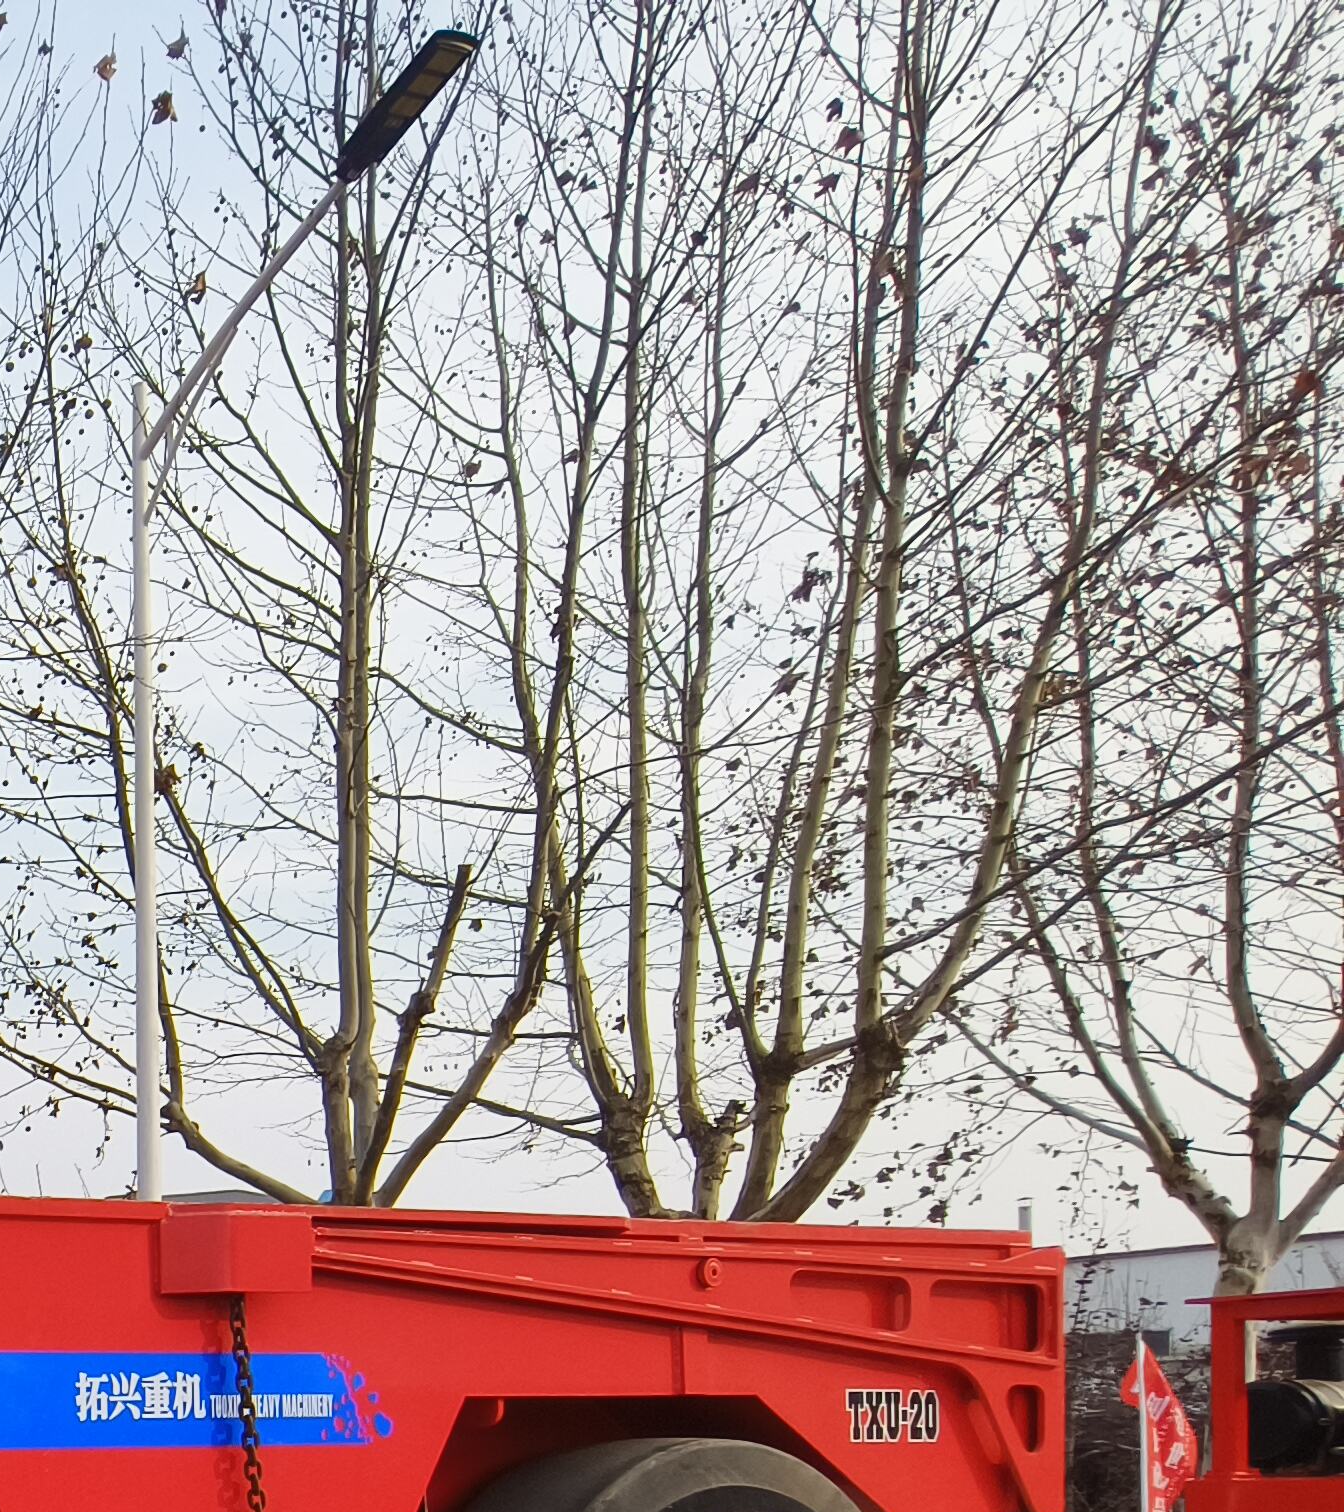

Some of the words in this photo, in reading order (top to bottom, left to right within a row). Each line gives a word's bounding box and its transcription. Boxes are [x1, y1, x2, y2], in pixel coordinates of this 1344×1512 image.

[75, 1371, 206, 1421] 拓兴重机
[209, 1394, 250, 1418] TUOXIN
[282, 1394, 334, 1418] MACHINERY
[845, 1388, 940, 1443] TXU-20
